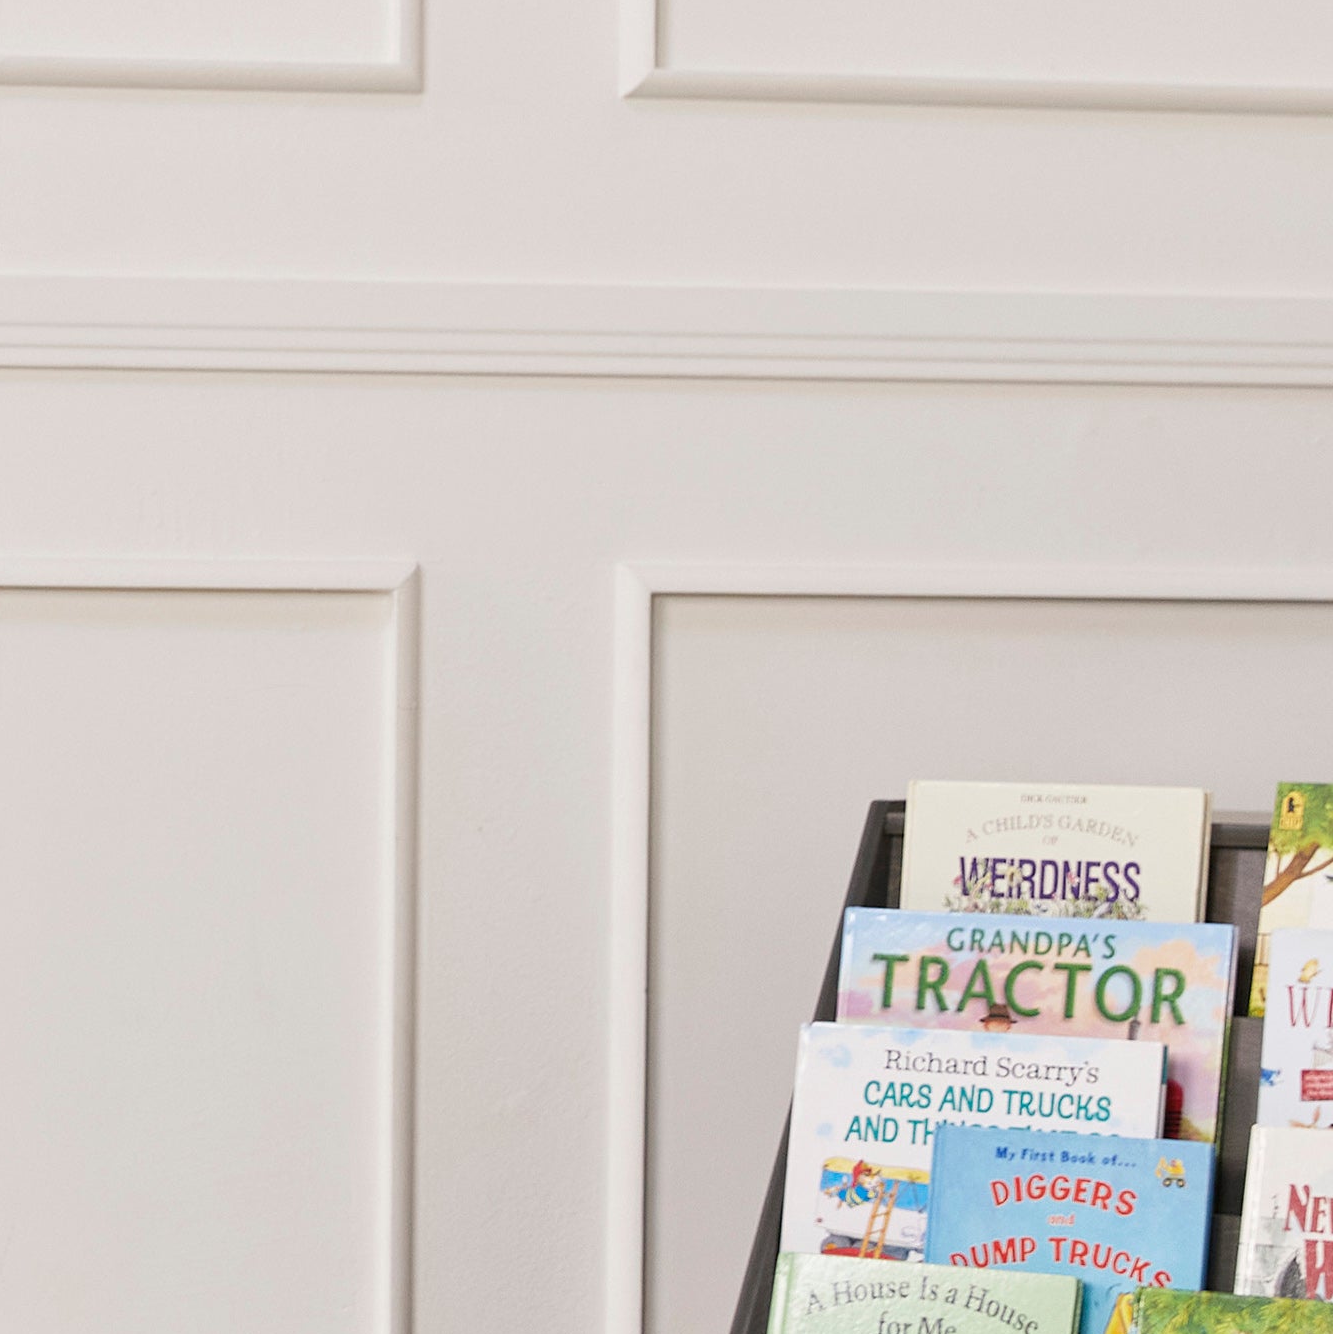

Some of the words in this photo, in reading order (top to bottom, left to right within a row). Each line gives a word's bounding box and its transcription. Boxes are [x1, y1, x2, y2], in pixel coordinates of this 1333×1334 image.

[966, 828, 979, 844] A
[1058, 814, 1139, 847] GARDEN
[959, 856, 1141, 903] WEIRDNESS
[946, 926, 1118, 960] GRANDPA'S
[872, 953, 1187, 1026] TRACTOR
[884, 1049, 988, 1078] Richard
[995, 1055, 1100, 1087] Scarry's
[864, 1080, 932, 1109] CARS
[938, 1084, 994, 1113] AND
[1003, 1089, 1111, 1122] TRUCKS
[844, 1114, 899, 1143] AND
[995, 1146, 1015, 1162] My
[1020, 1148, 1055, 1163] First
[1060, 1150, 1095, 1165] Book
[990, 1173, 1138, 1216] DIGGERS
[1047, 1214, 1076, 1226] and
[949, 1236, 1037, 1267] DUMP
[804, 1292, 827, 1316] A
[832, 1277, 911, 1307] House
[918, 1275, 939, 1302] Is
[945, 1286, 958, 1305] a
